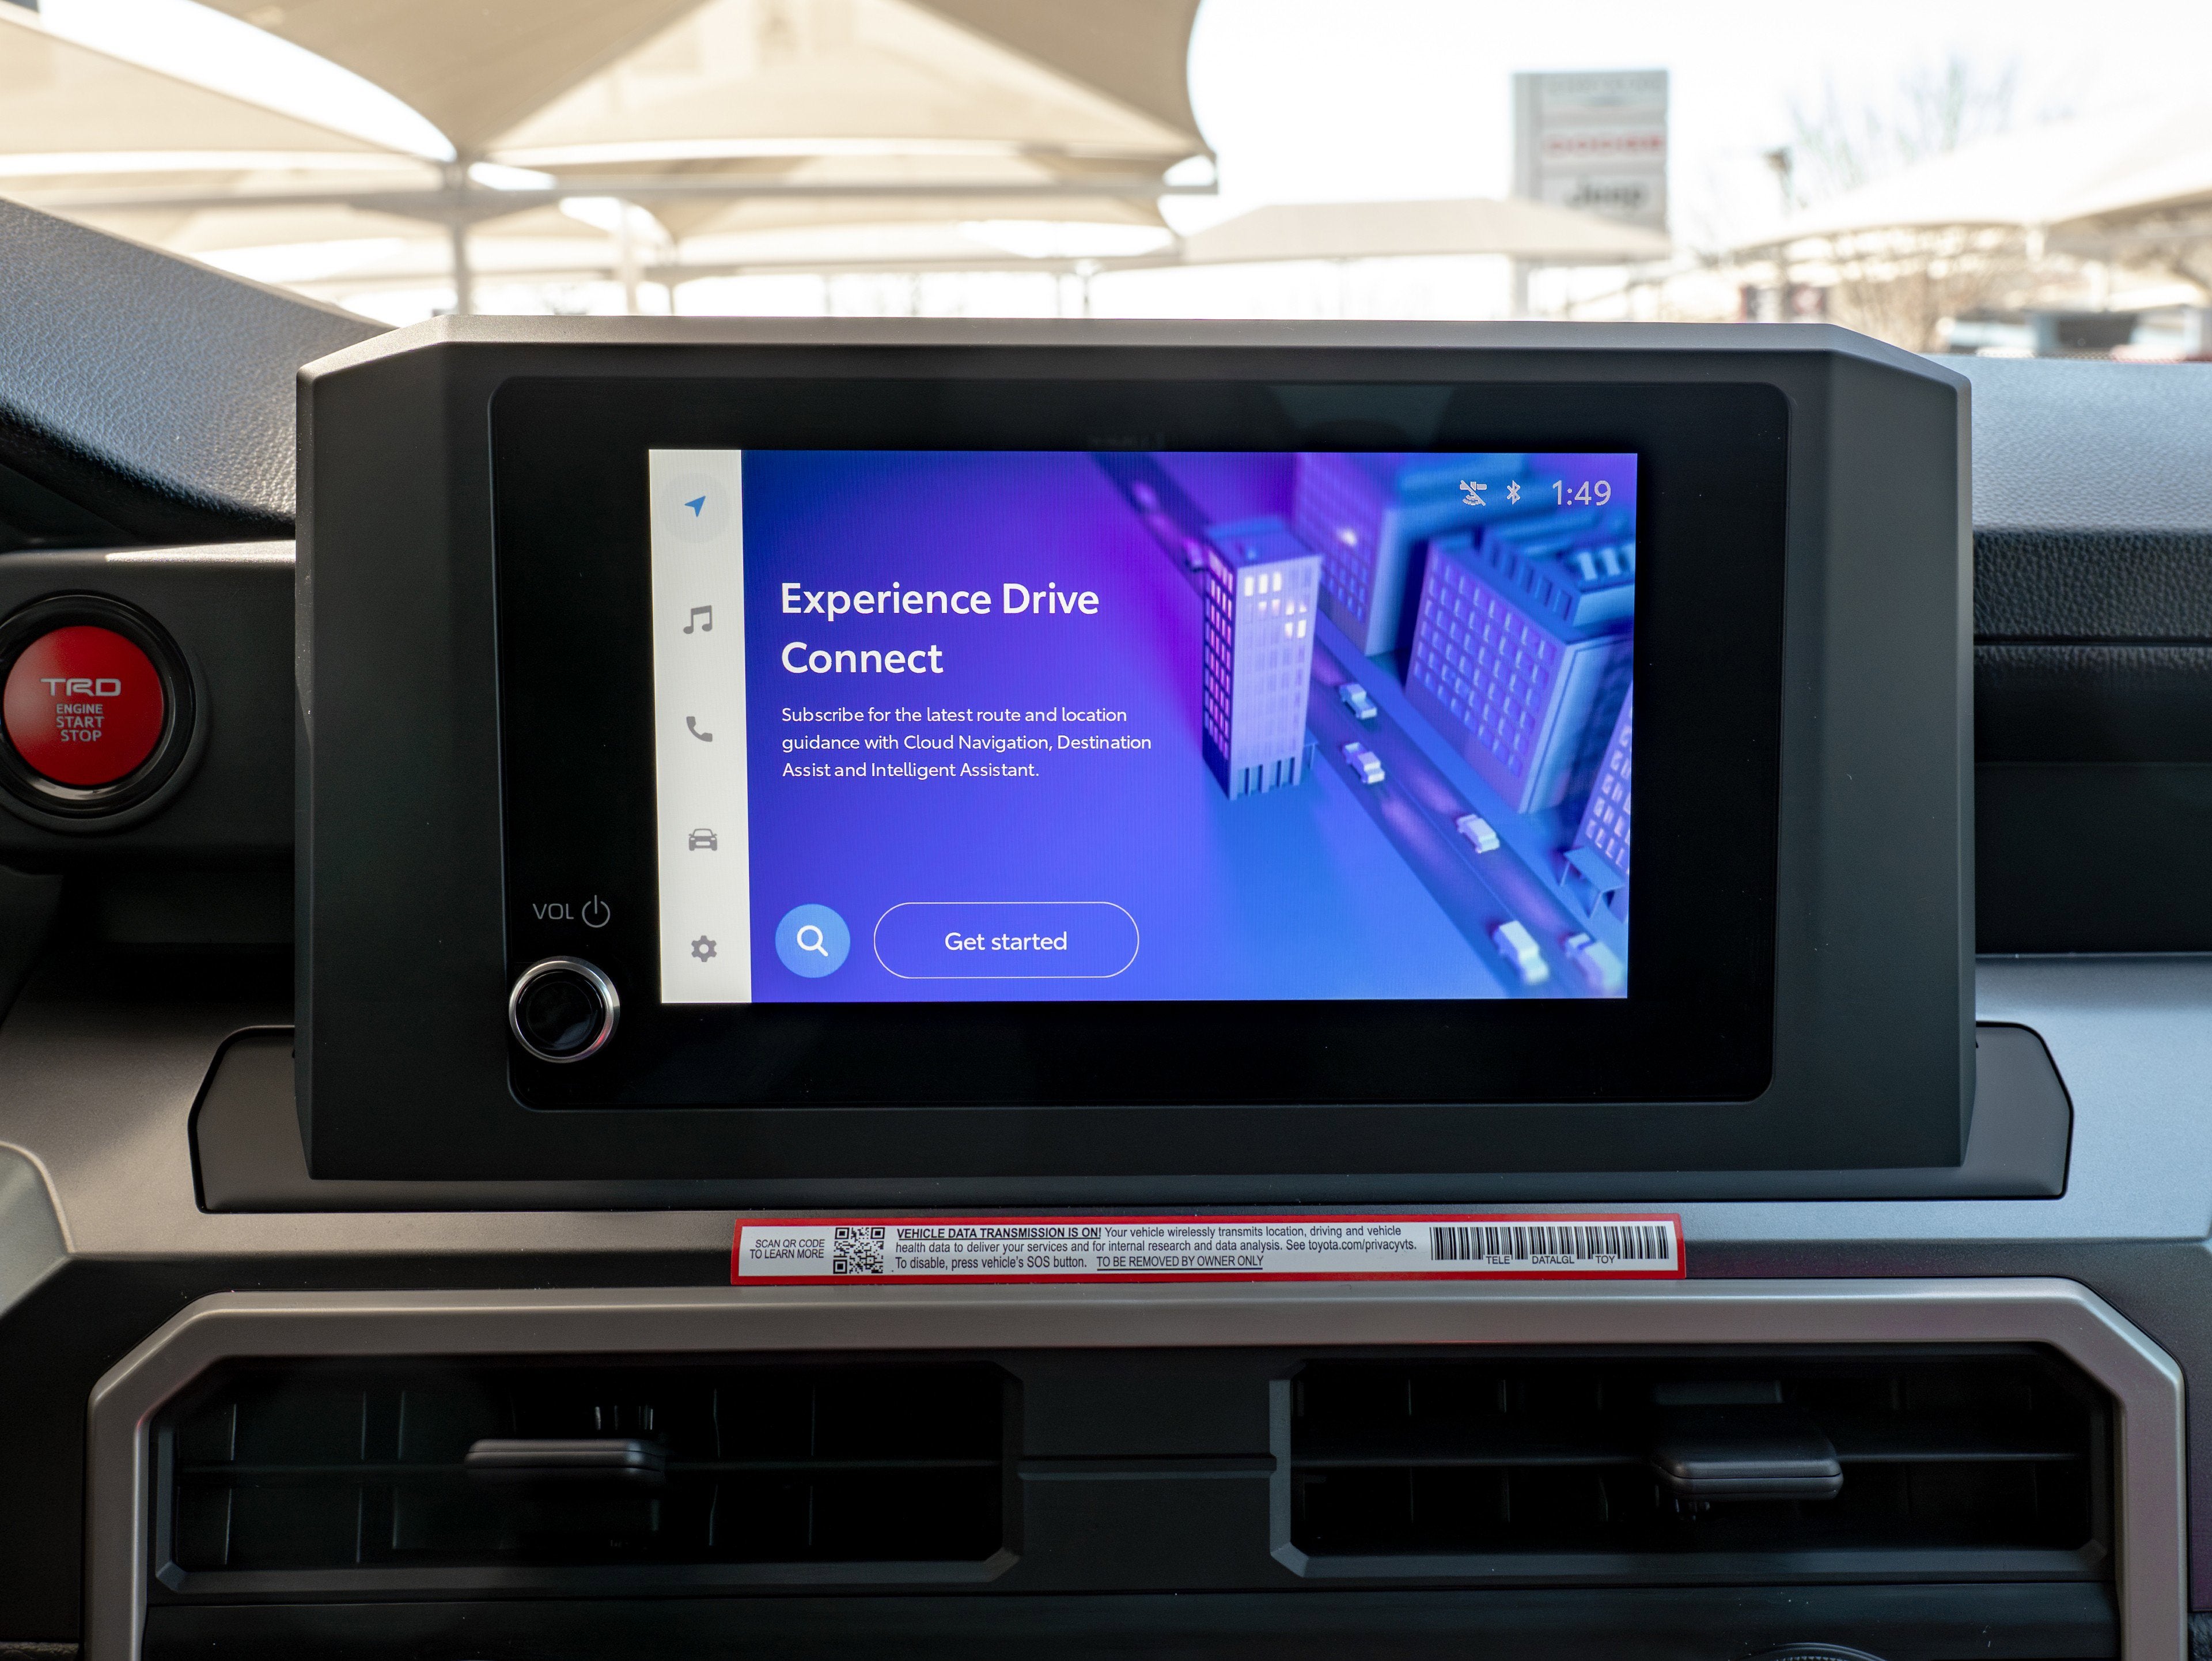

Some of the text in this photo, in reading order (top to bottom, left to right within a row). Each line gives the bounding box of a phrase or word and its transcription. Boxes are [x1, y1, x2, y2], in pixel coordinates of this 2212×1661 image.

[1552, 480, 1611, 506] 1:49
[781, 582, 1099, 622] Experience Drive
[782, 642, 944, 674] Connect
[40, 678, 121, 697] TRD
[56, 703, 103, 714] ENGINE
[782, 707, 1127, 722] Subscribe for the latest route and location
[56, 716, 104, 728] START
[60, 730, 102, 741] STOP
[782, 734, 1152, 754] guidance with Cloud Navigation, Destination
[782, 762, 1039, 781] Assist and Intelligent Assistant.
[532, 903, 574, 920] VOL
[945, 931, 1067, 951] Get started
[897, 1225, 1401, 1239] VEHICLE DATA TRANSMISSION IS ON! Your vehicle wirelessly transmits location, driving and vehicle
[755, 1239, 825, 1248] SCAN QR CODE
[896, 1239, 1416, 1255] health data to deliver your services and for internal research and data analysis. See toyota.com/privacyvts.
[750, 1249, 824, 1259] TO LEARN MORE
[1486, 1255, 1615, 1264] TELE DATALGL TOY
[896, 1255, 1263, 1271] To disable, press vehicle's SOS button. TO BE REMOVED BY OWNER ONLY
